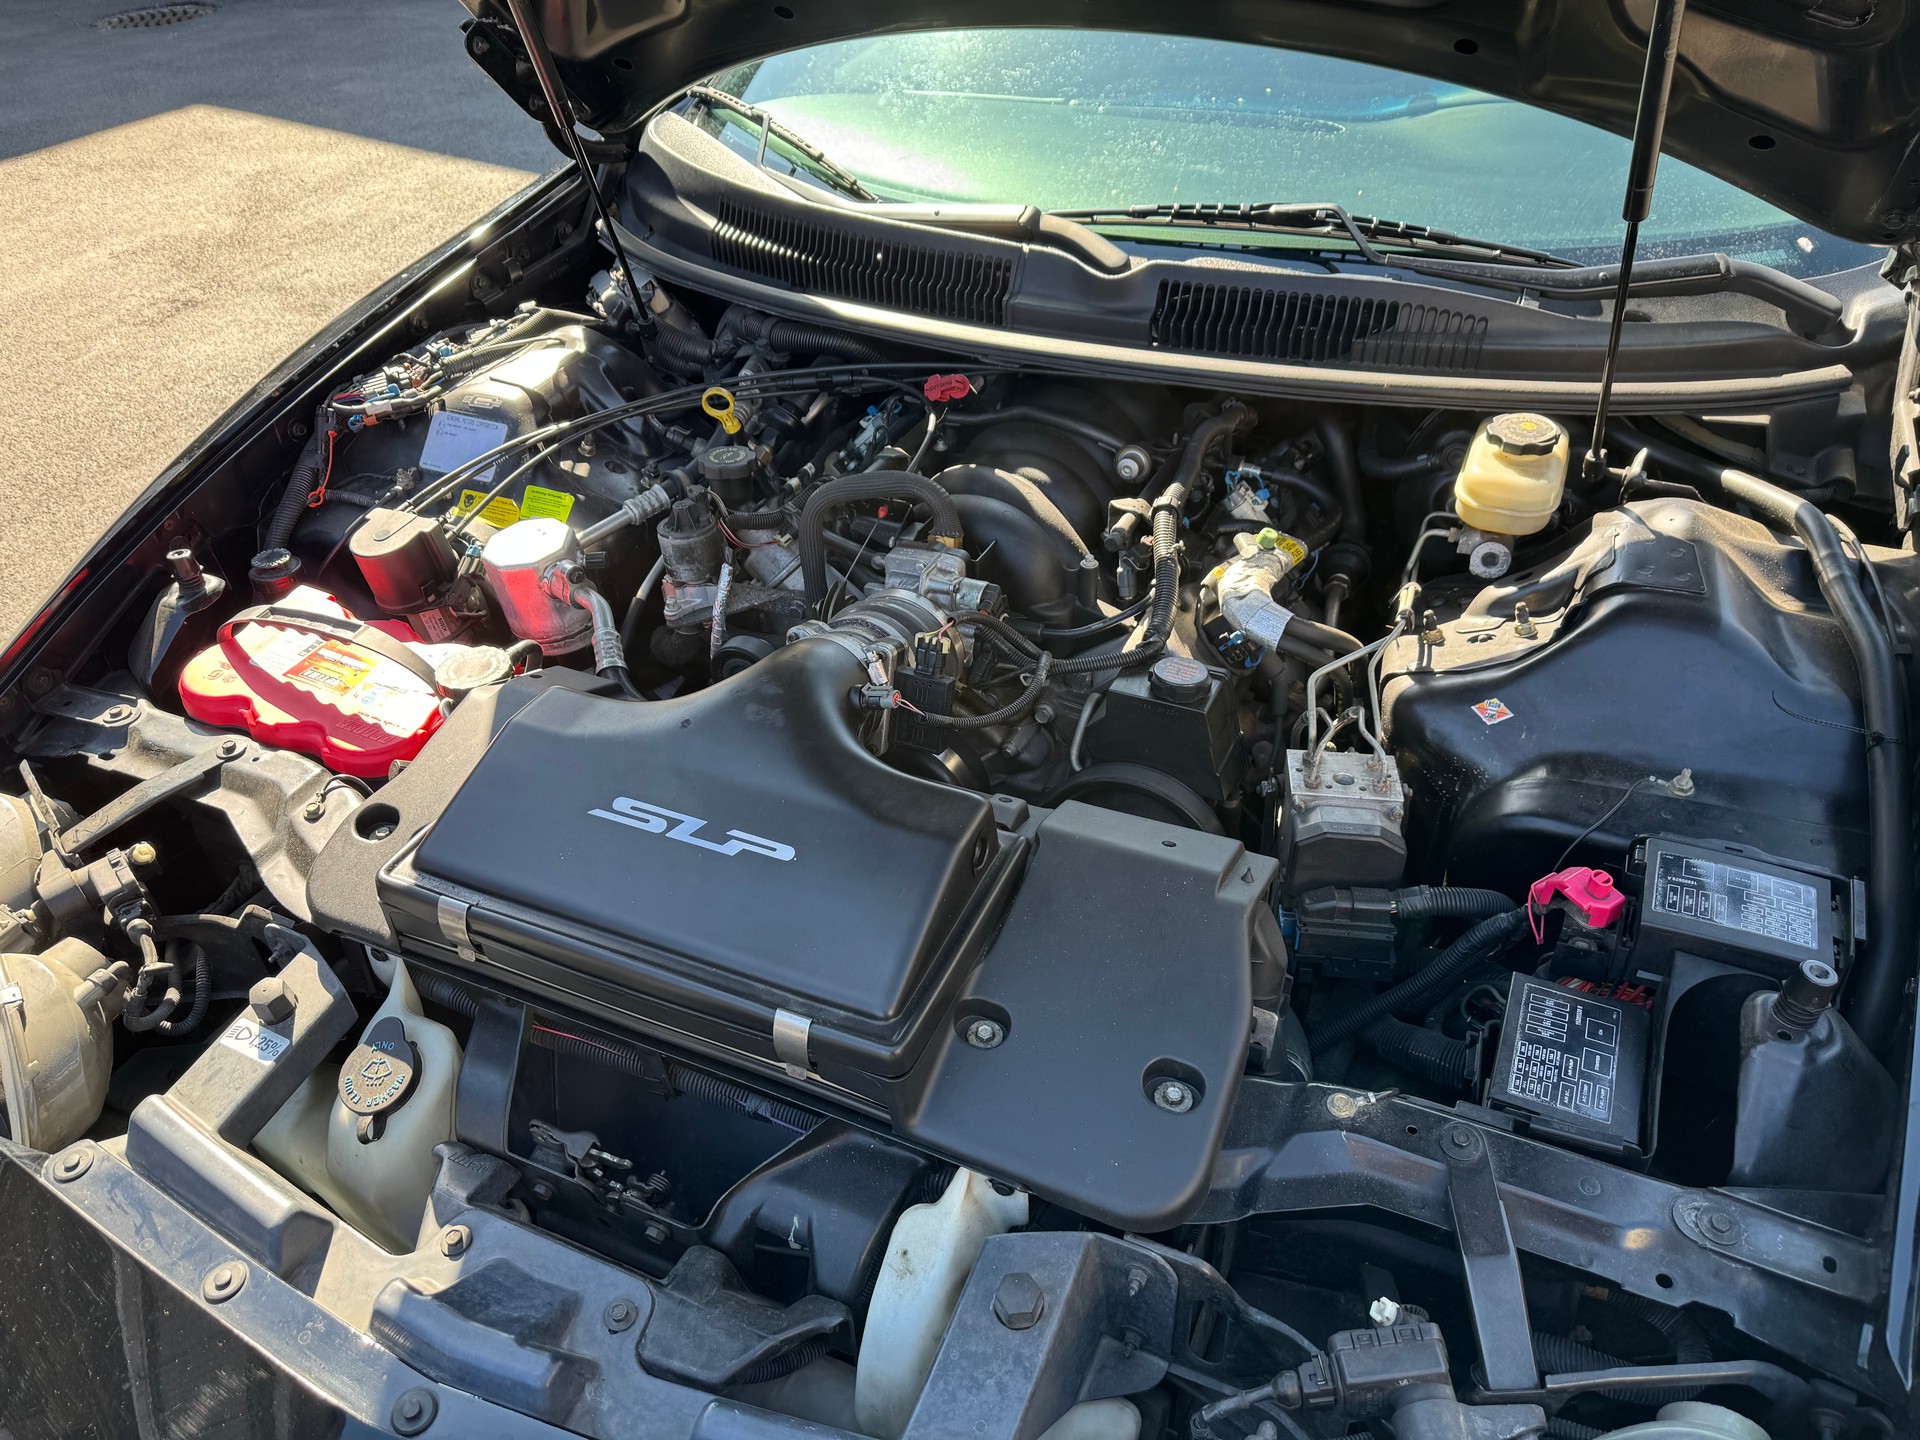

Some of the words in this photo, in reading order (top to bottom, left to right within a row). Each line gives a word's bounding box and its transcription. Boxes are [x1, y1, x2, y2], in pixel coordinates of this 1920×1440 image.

[587, 796, 796, 862] SLP
[248, 1032, 285, 1058] 1,25%
[371, 1041, 395, 1053] ONLY
[345, 1076, 361, 1105] FLUID
[366, 1073, 406, 1108] WASHER
